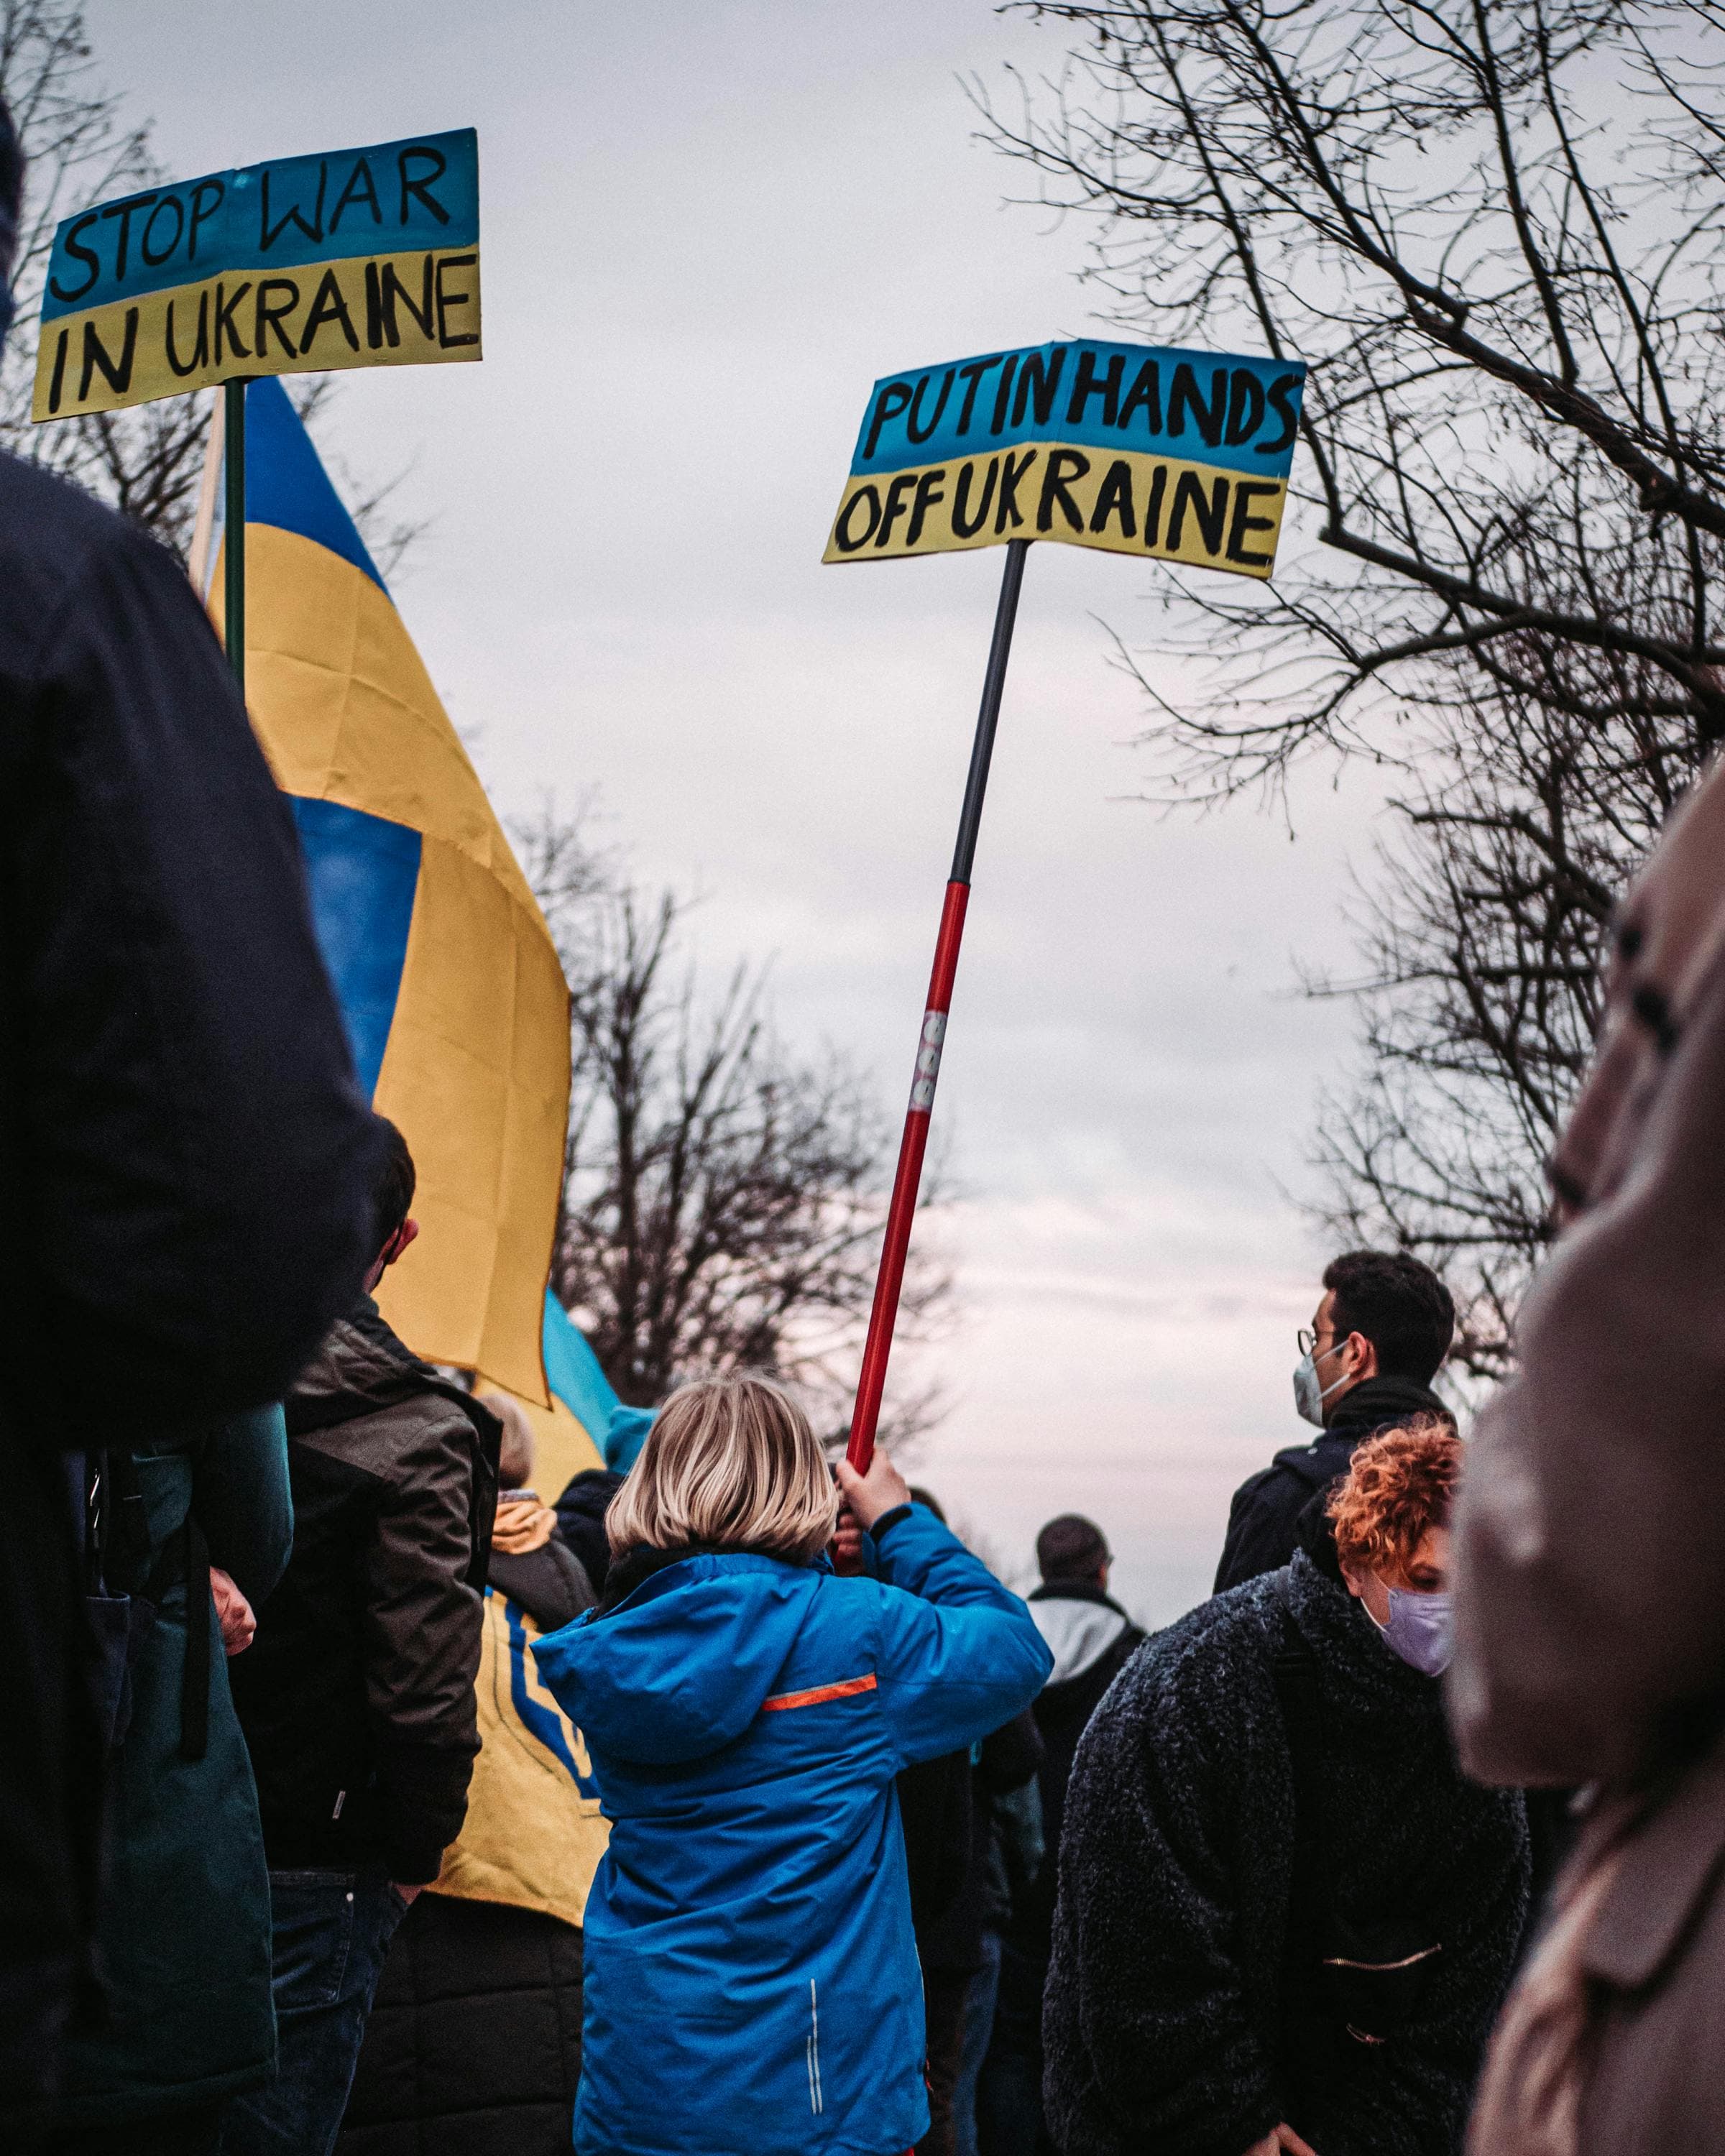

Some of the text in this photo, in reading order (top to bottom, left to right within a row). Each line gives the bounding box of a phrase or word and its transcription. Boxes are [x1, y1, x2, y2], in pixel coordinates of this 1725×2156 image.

[50, 146, 450, 303] STOP WAR
[48, 253, 479, 414] IN UKRAINE
[863, 347, 1305, 460] PUTIN HANDS
[835, 449, 1281, 565] OFF UKRAINE
